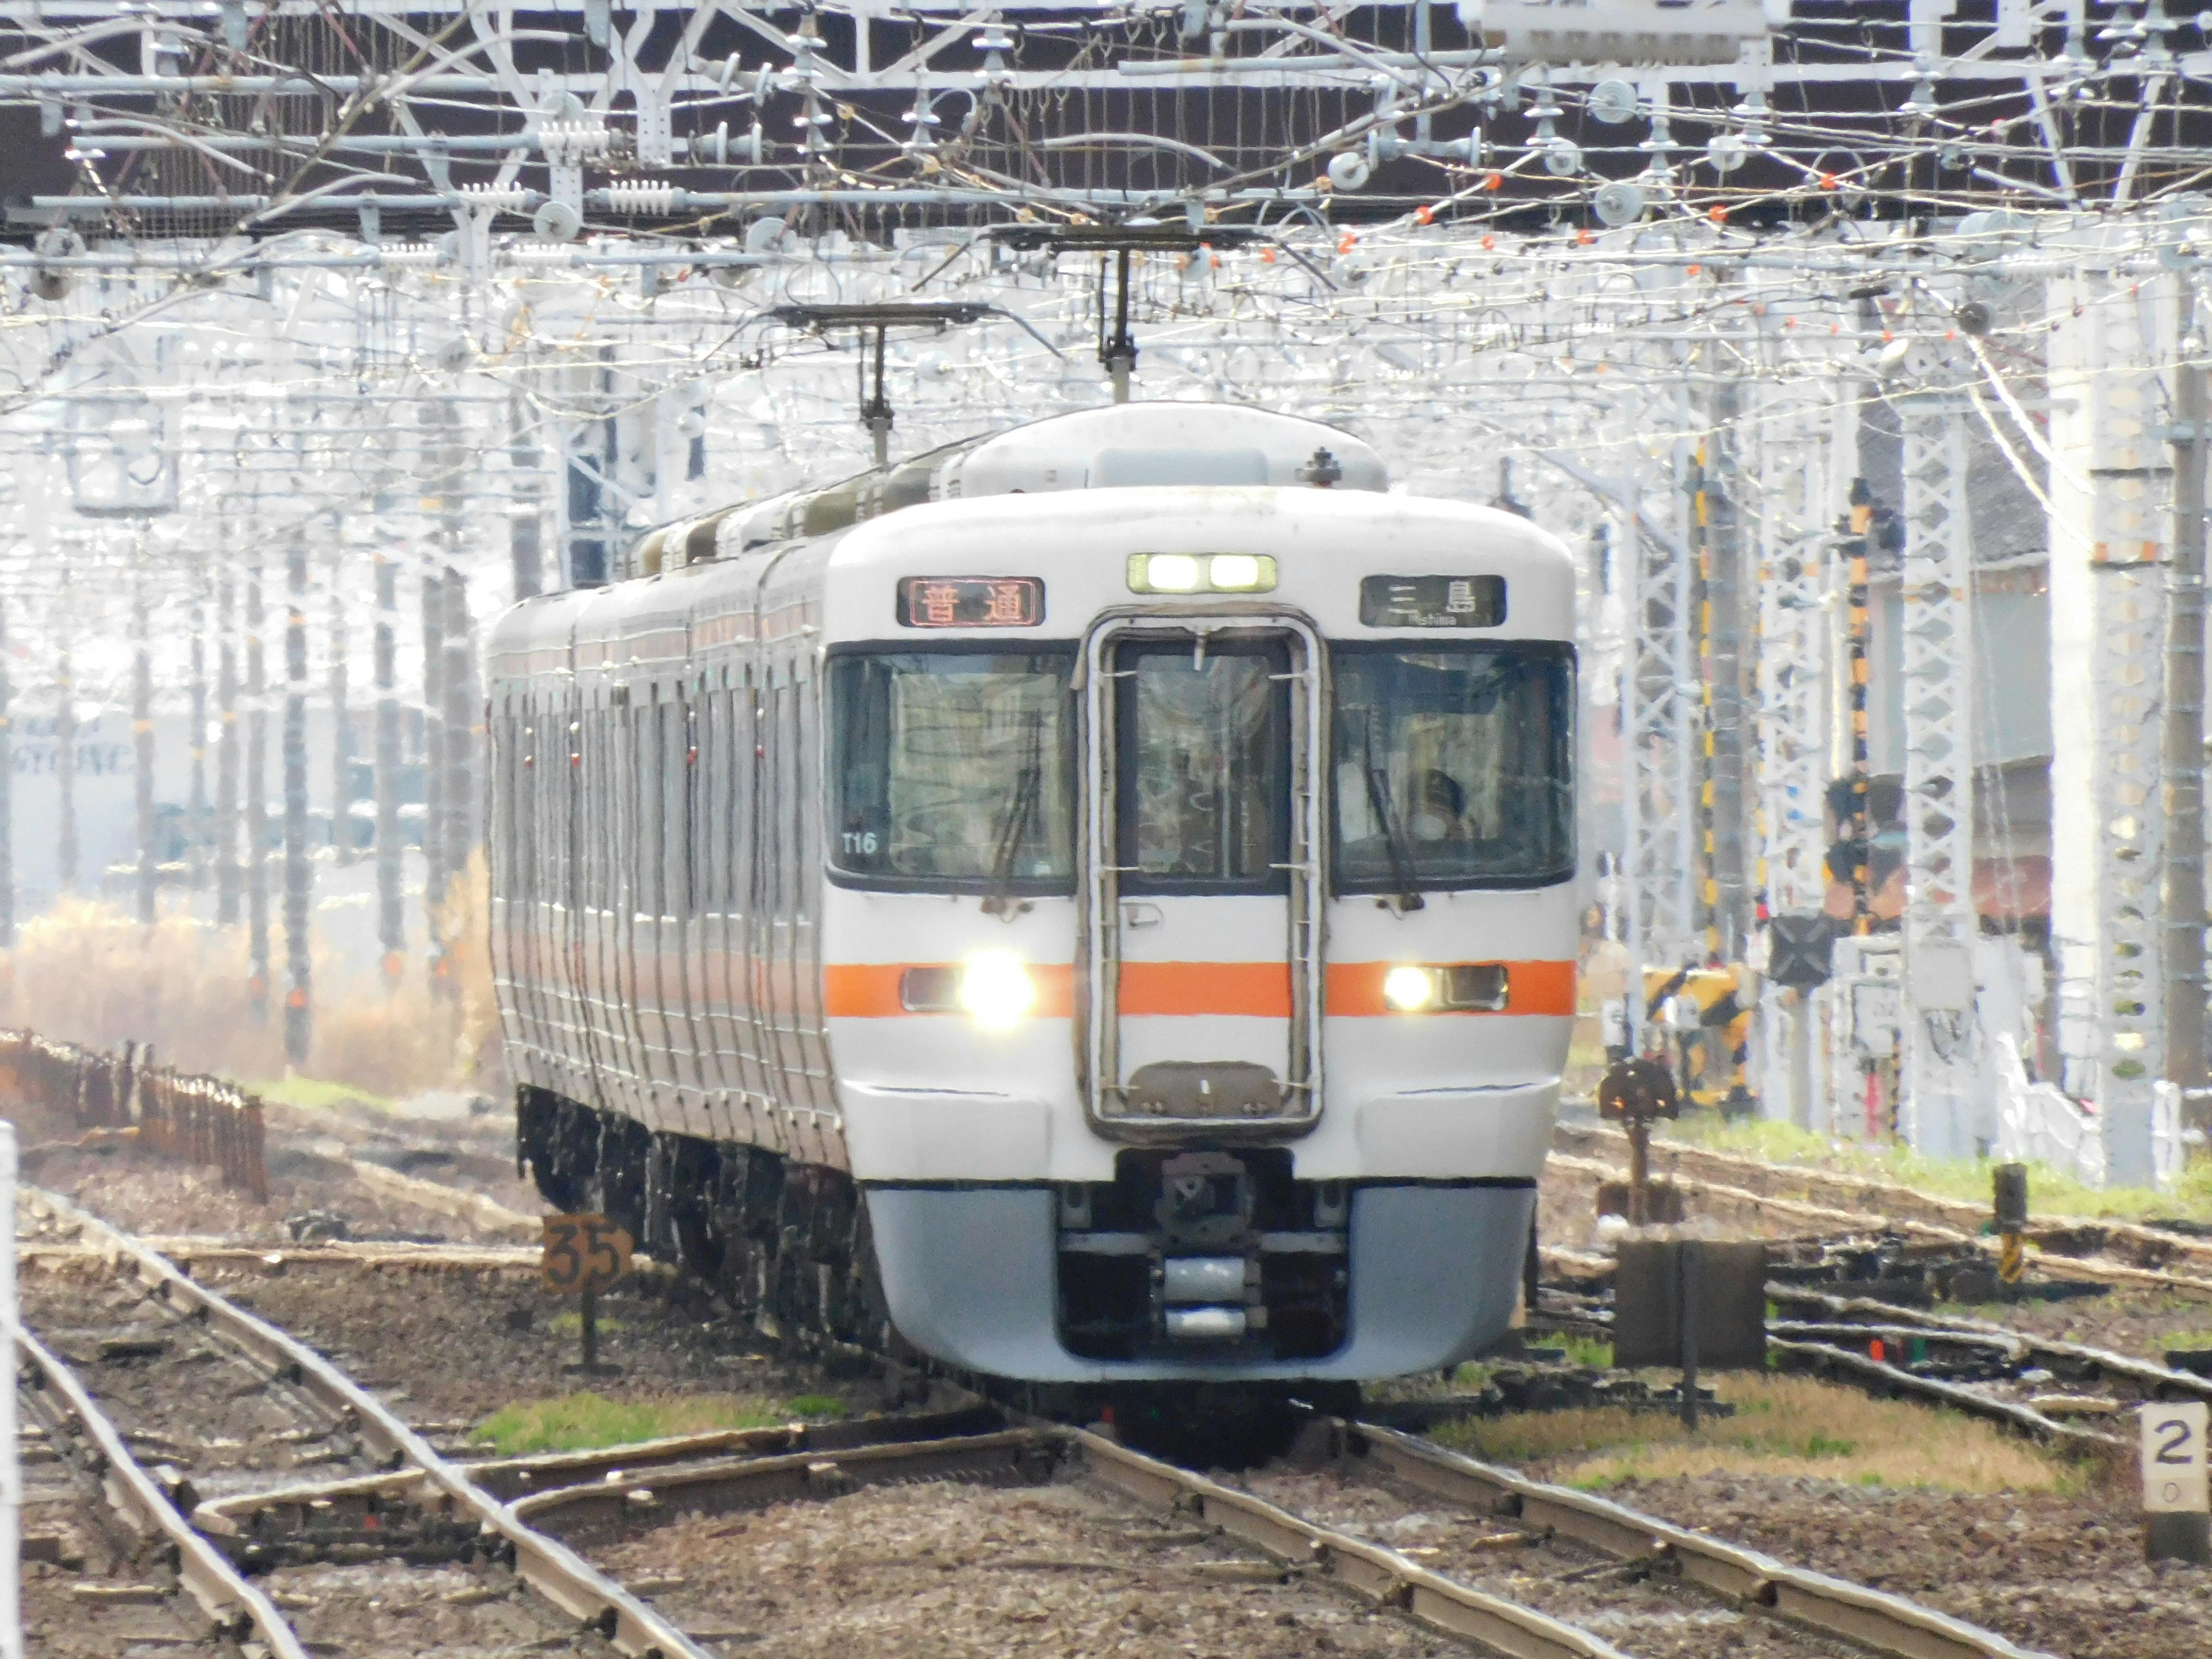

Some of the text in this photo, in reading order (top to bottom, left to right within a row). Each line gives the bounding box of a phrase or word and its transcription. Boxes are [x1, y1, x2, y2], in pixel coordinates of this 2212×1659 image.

[922, 585, 1022, 622] 普通
[1387, 581, 1476, 613] 三島
[842, 832, 877, 854] T16
[549, 1224, 620, 1285] 35
[2154, 1419, 2194, 1464] 2
